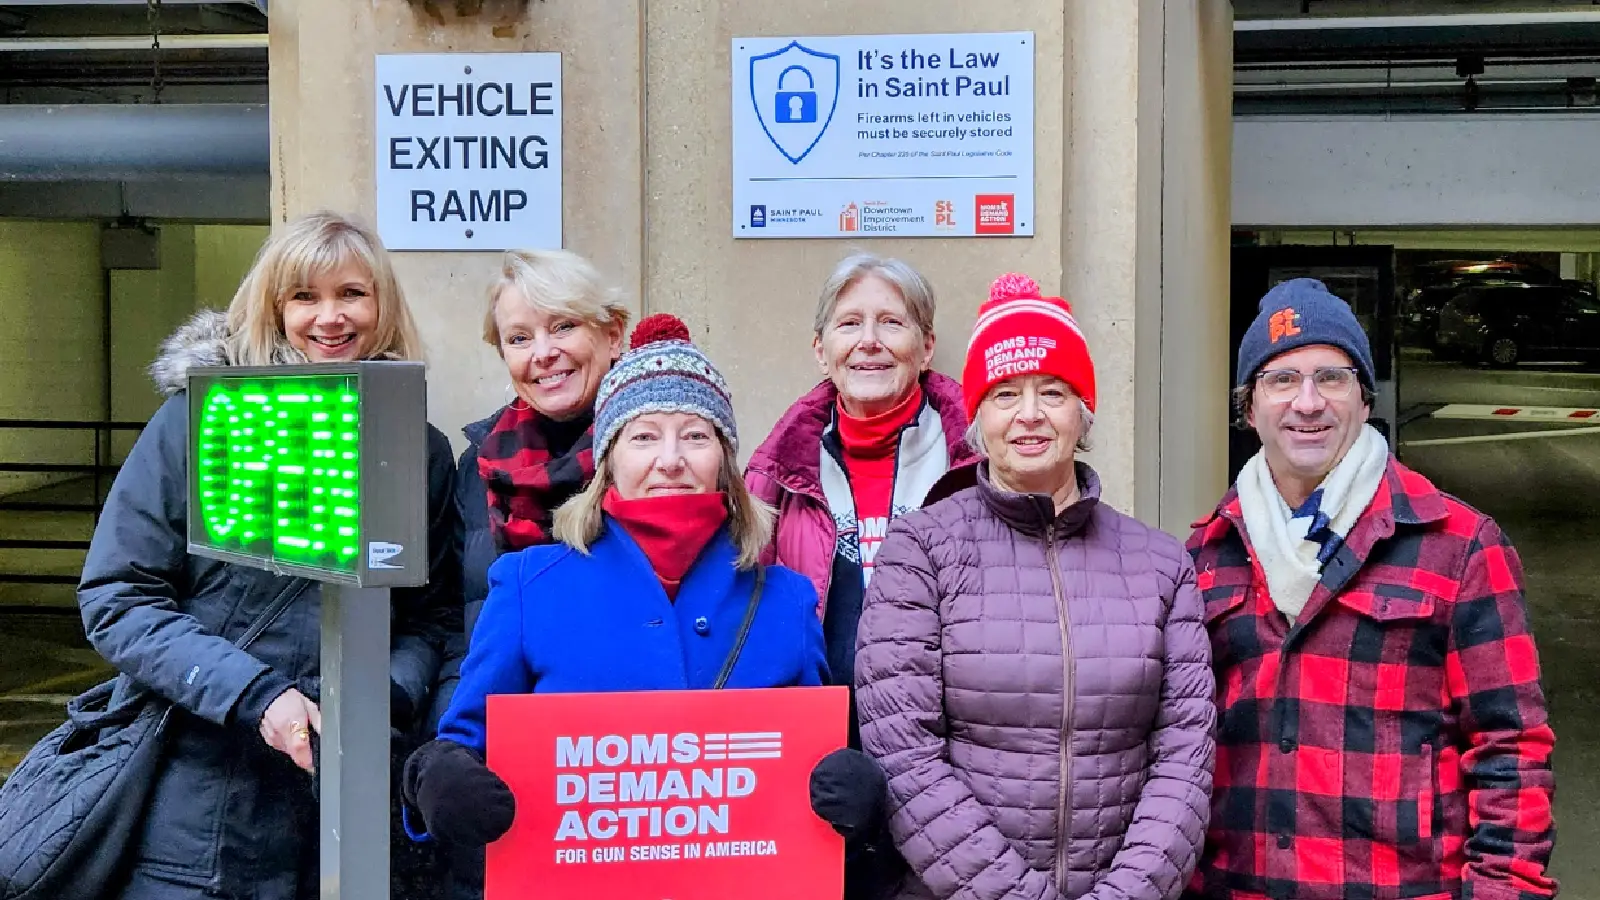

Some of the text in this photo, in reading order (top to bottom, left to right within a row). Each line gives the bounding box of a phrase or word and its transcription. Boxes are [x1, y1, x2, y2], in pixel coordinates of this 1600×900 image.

[858, 47, 999, 70] It's the Law
[858, 74, 1010, 97] in Saint Paul
[383, 82, 554, 117] VEHICLE
[857, 109, 1012, 124] Firearms left in vehicles
[857, 125, 1013, 140] must be securely stored
[389, 135, 549, 170] EXITING
[411, 189, 528, 222] RAMP
[770, 208, 823, 217] SAINT PAUL
[863, 206, 913, 214] Downtown
[863, 215, 925, 224] Improvement
[984, 335, 1026, 360] MOMS
[986, 347, 1047, 370] DEMAND
[987, 359, 1040, 383] ACTION
[201, 390, 358, 558] OPEN
[556, 732, 701, 768] MOMS
[556, 767, 757, 804] DEMAND
[553, 804, 729, 841] ACTION
[555, 840, 777, 864] FOR GUN SENSE IN AMERICA
